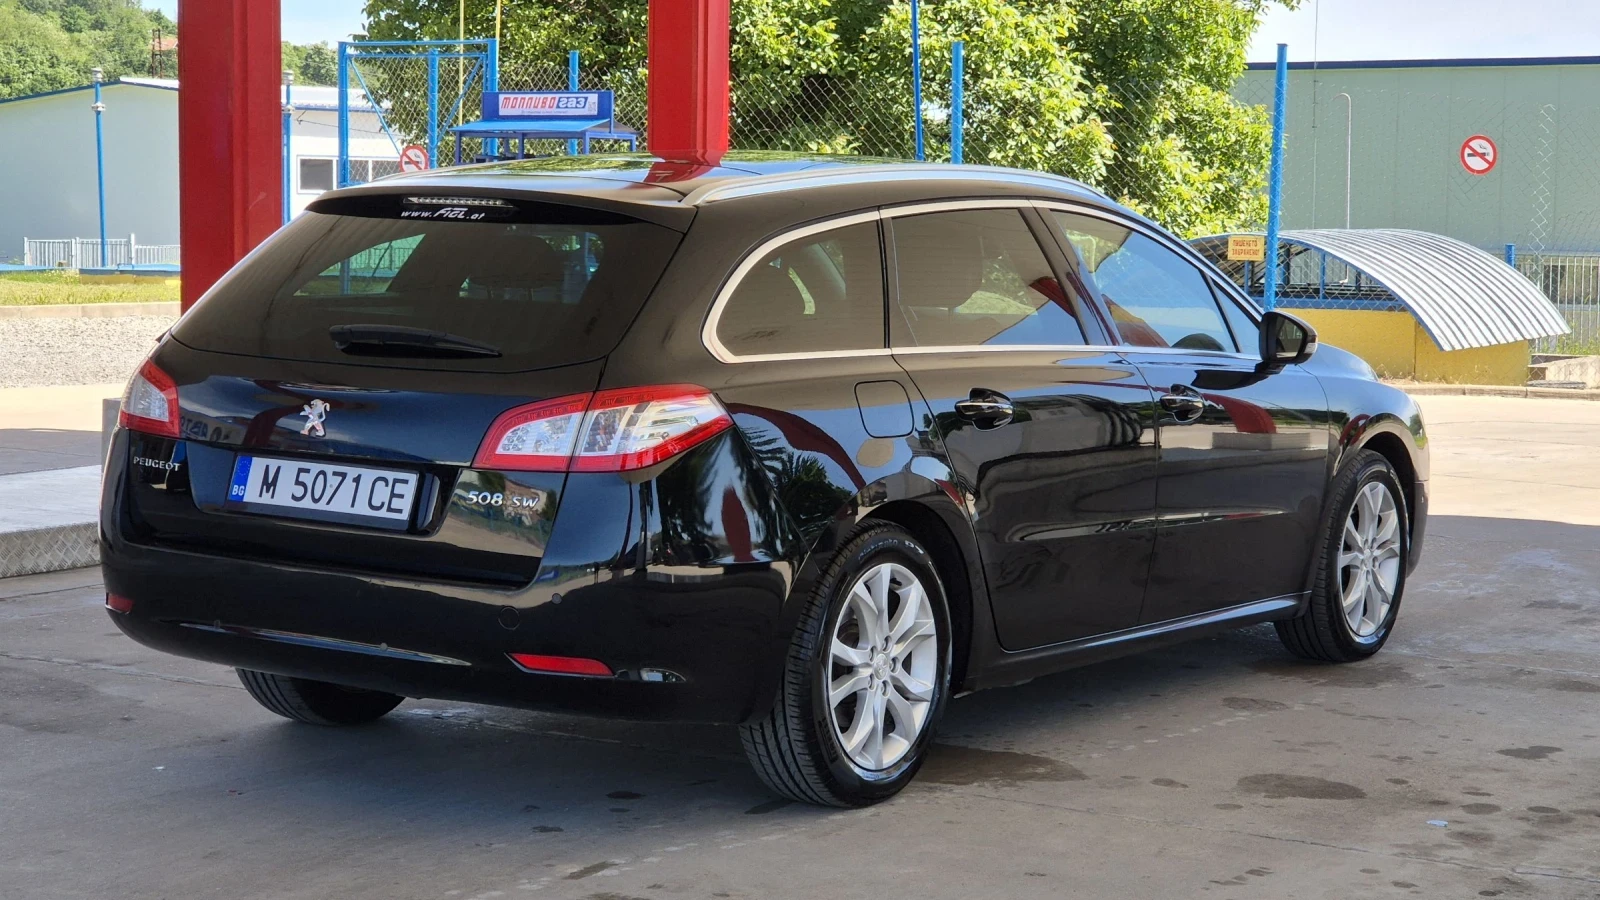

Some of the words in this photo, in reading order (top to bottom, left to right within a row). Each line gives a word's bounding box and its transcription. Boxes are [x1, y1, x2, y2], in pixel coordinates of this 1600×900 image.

[133, 456, 181, 472] PEUGEOT
[231, 484, 245, 496] BG
[258, 464, 281, 499] M
[467, 489, 503, 507] 508
[512, 495, 540, 510] SW
